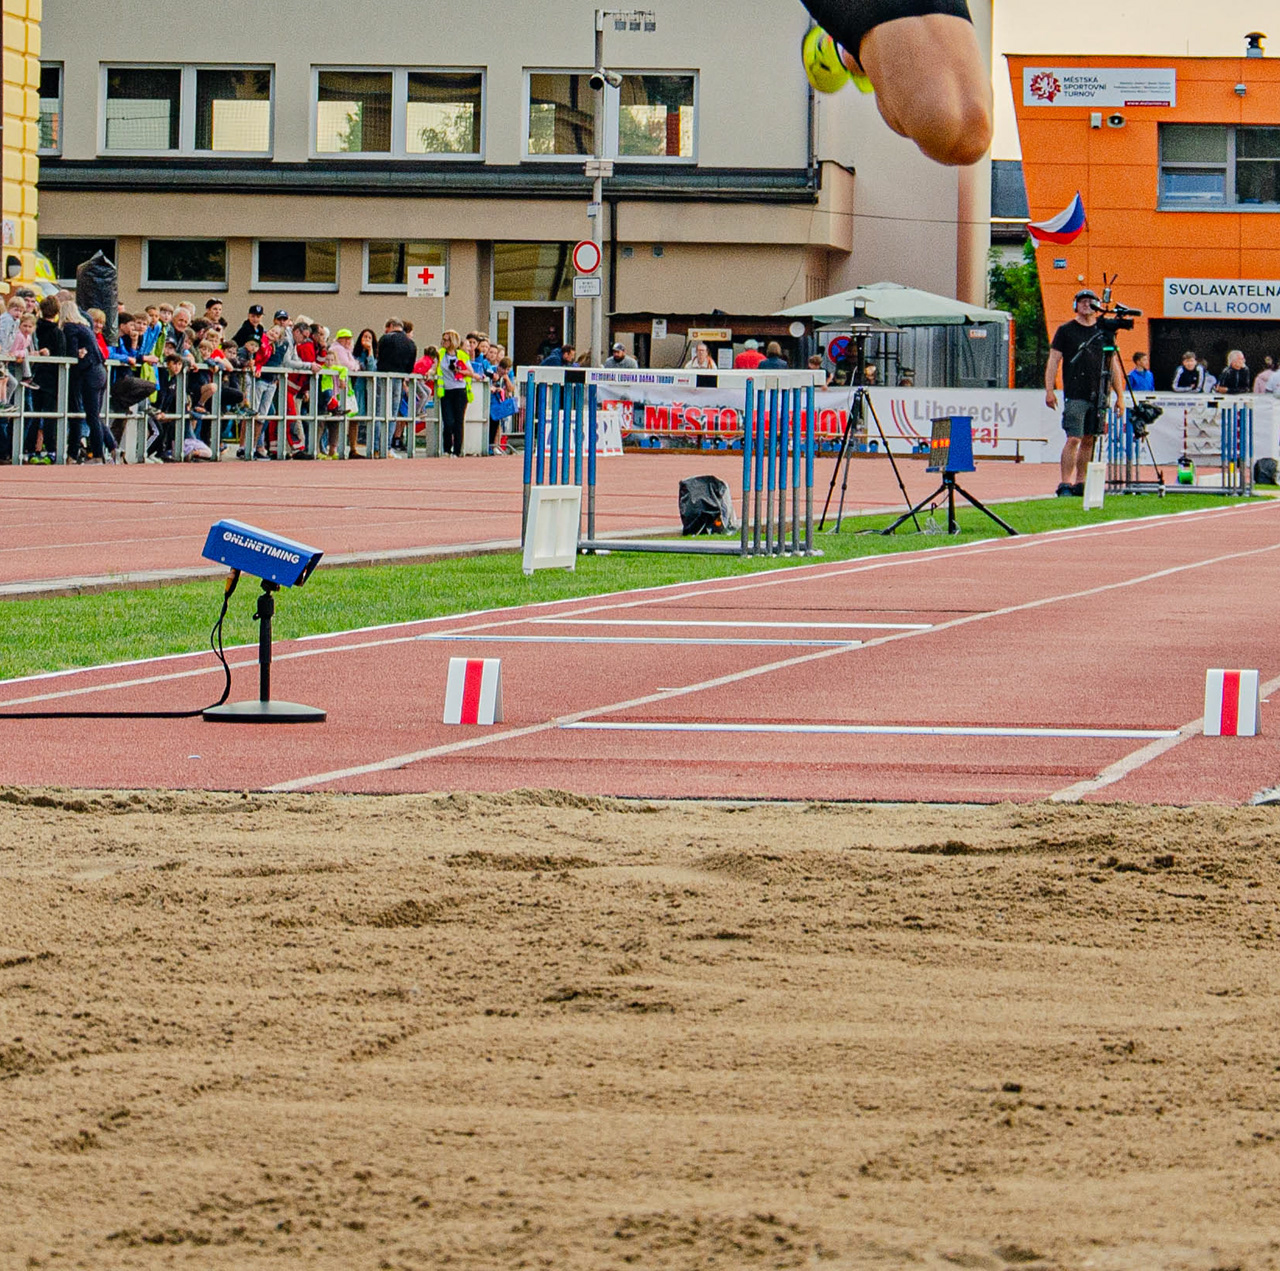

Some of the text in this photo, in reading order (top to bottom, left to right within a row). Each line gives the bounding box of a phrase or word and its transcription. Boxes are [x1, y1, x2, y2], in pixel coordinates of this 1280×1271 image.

[1183, 301, 1271, 314] CALL ROOM
[645, 401, 738, 438] MĚSTO
[971, 423, 999, 448] raj
[223, 532, 299, 564] ONLINETIMING
